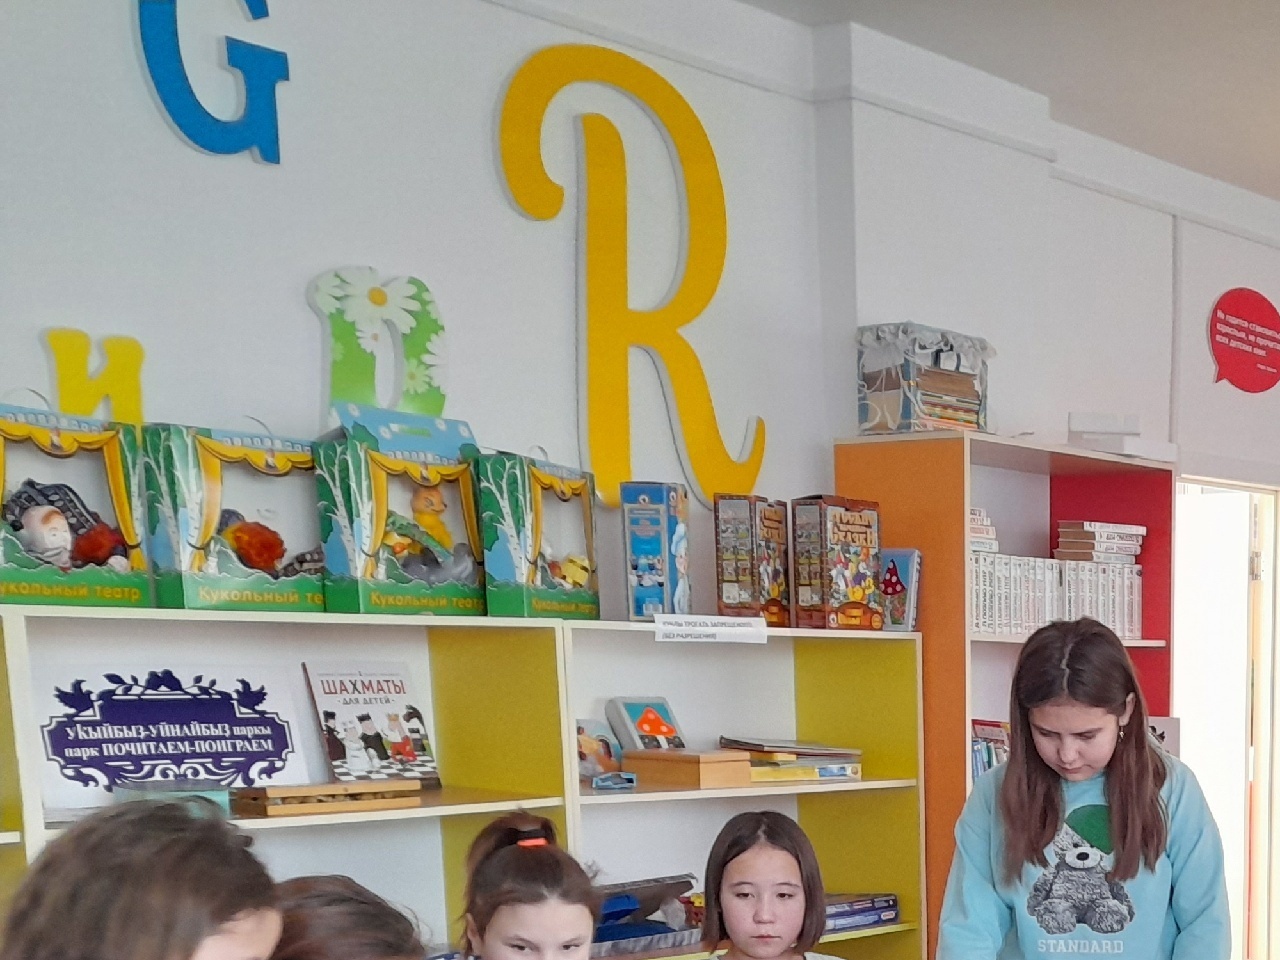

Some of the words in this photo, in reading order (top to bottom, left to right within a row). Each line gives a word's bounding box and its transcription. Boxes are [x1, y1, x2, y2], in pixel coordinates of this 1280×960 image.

[499, 44, 766, 509] R
[0, 580, 89, 598] укольный
[95, 583, 142, 602] театр
[200, 585, 299, 606] Кукольный
[370, 591, 447, 608] Кукольный
[320, 679, 406, 695] ШАХМАТЫ
[232, 726, 272, 739] паркы
[64, 746, 100, 761] парк
[101, 739, 274, 757] ПОЧИТАЕМ-ПОИГРАЕМ
[1037, 939, 1124, 954] STANDARD
